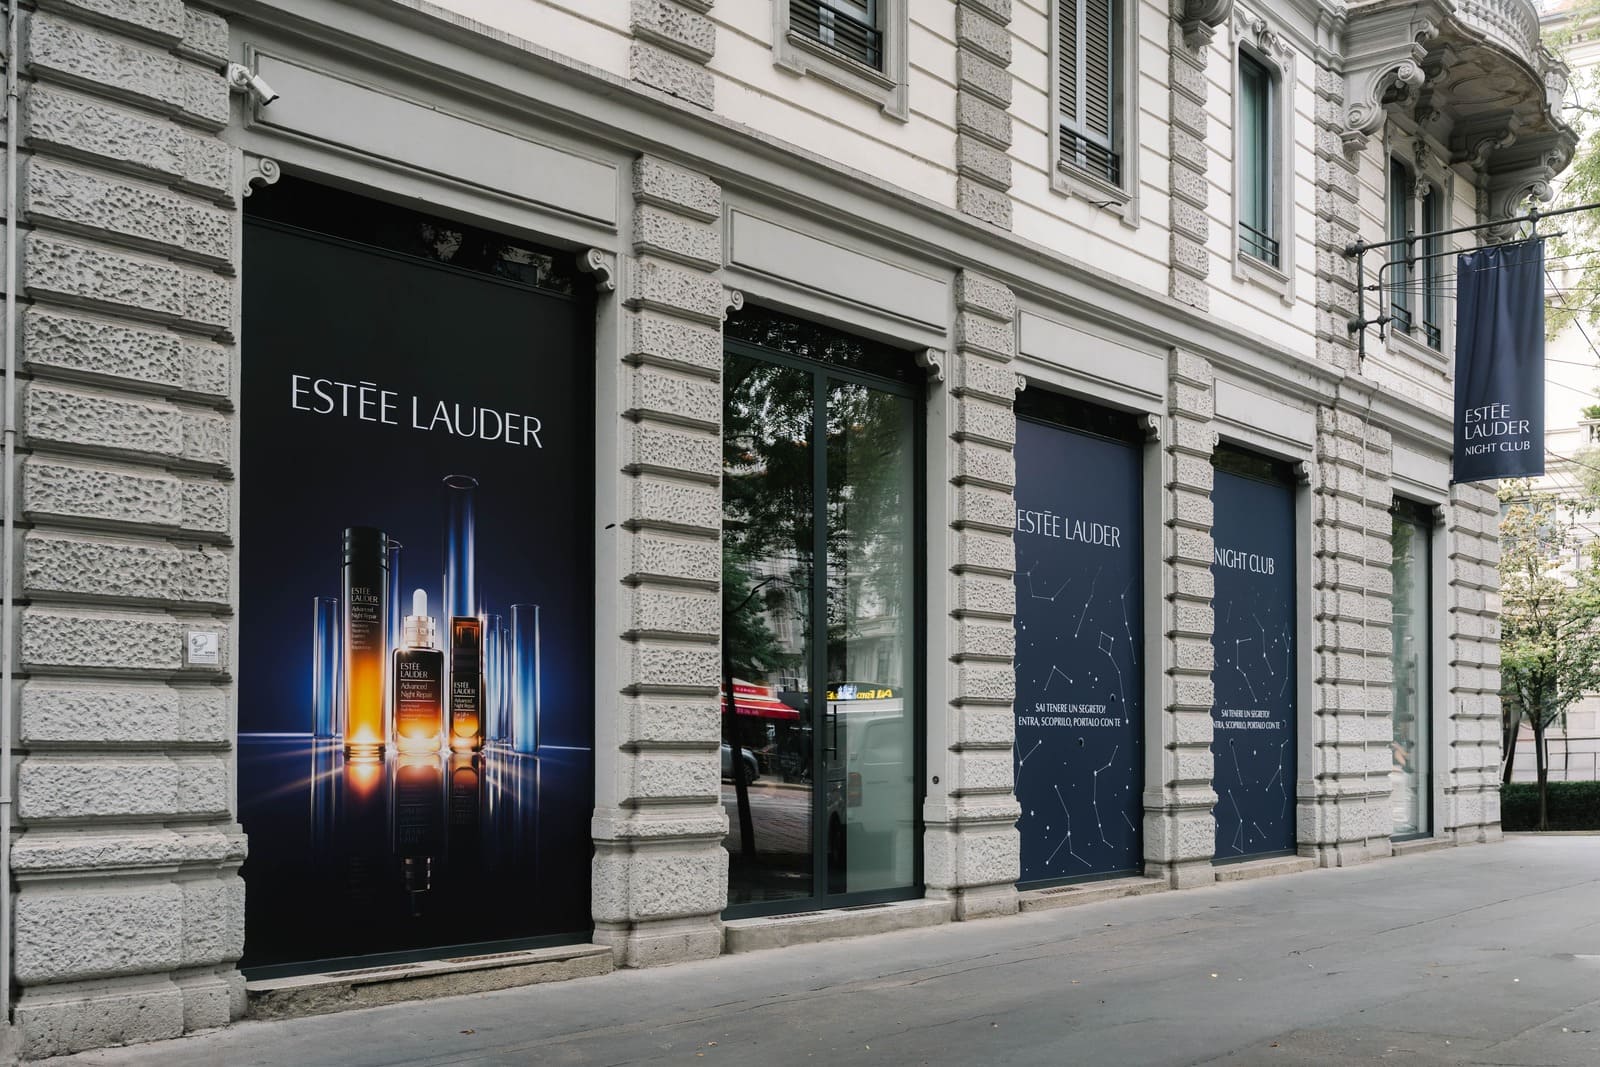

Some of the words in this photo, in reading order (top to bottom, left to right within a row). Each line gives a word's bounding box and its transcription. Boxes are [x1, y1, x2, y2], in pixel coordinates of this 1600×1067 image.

[412, 395, 543, 449] LAUDER
[1465, 419, 1530, 440] LAUDER
[1465, 442, 1497, 456] NIGHT
[1500, 440, 1531, 452] CLUB
[1065, 517, 1121, 549] LAUDER
[1214, 546, 1248, 571] NIGHT
[1249, 553, 1275, 575] CLUB
[351, 594, 378, 603] LAUDER
[400, 670, 428, 679] LAUDER
[400, 682, 428, 690] Advanced
[400, 690, 416, 699] Night
[1035, 703, 1046, 713] SAI
[1046, 703, 1068, 713] TENERE
[1068, 703, 1078, 713] UN
[1018, 716, 1040, 727] ENTRA,
[1073, 717, 1100, 727] PORTALO
[1100, 717, 1115, 727] CON
[1114, 718, 1121, 727] TE
